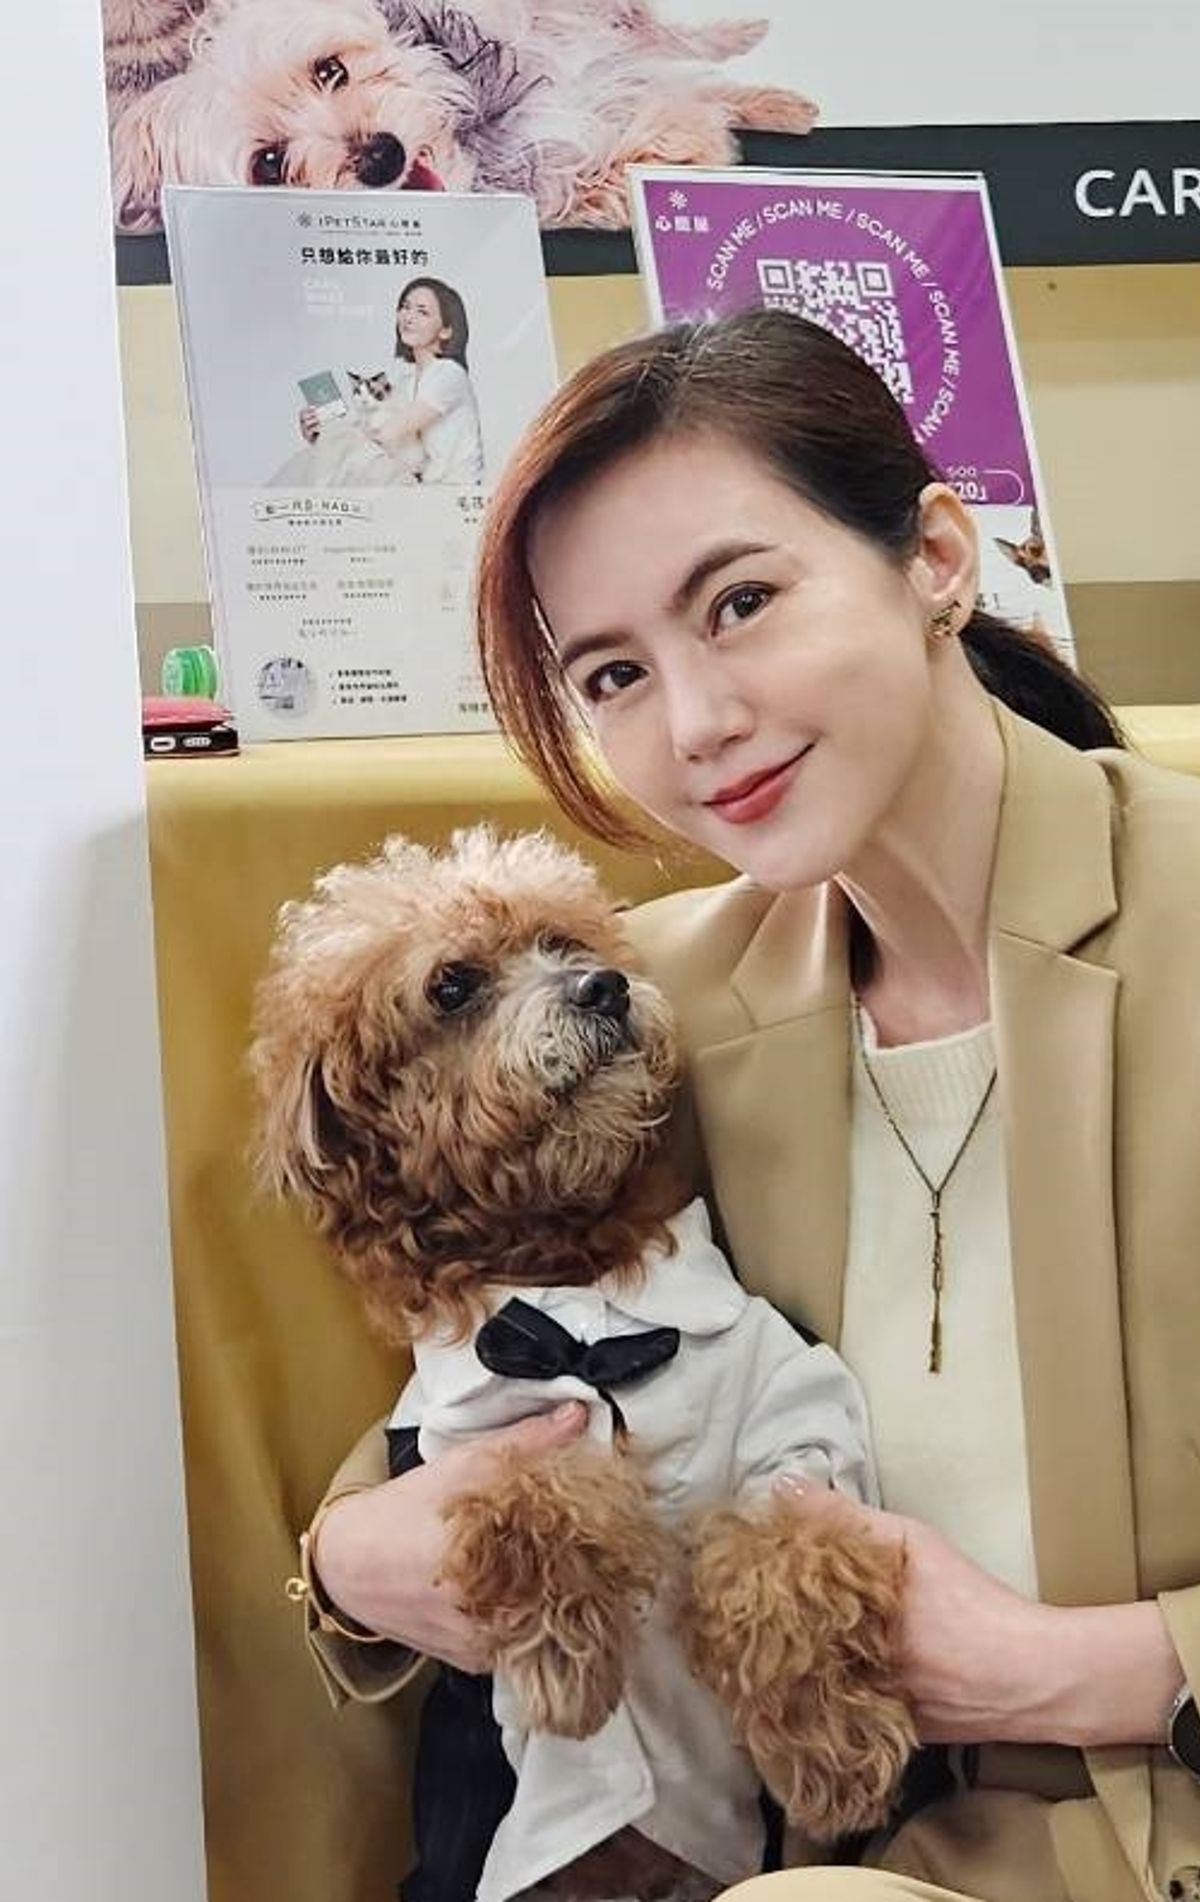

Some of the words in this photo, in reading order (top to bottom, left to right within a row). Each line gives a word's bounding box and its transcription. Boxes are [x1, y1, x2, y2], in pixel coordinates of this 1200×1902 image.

[762, 199, 814, 224] SCAN
[815, 198, 844, 220] ME
[730, 218, 758, 246] ME
[856, 212, 908, 255] SCAN
[301, 246, 429, 267] 只想給你最好的
[706, 239, 739, 291] SCAN
[902, 250, 931, 279] ME
[928, 289, 959, 346] SCAN
[942, 350, 962, 378] ME
[918, 386, 956, 439] SCAN
